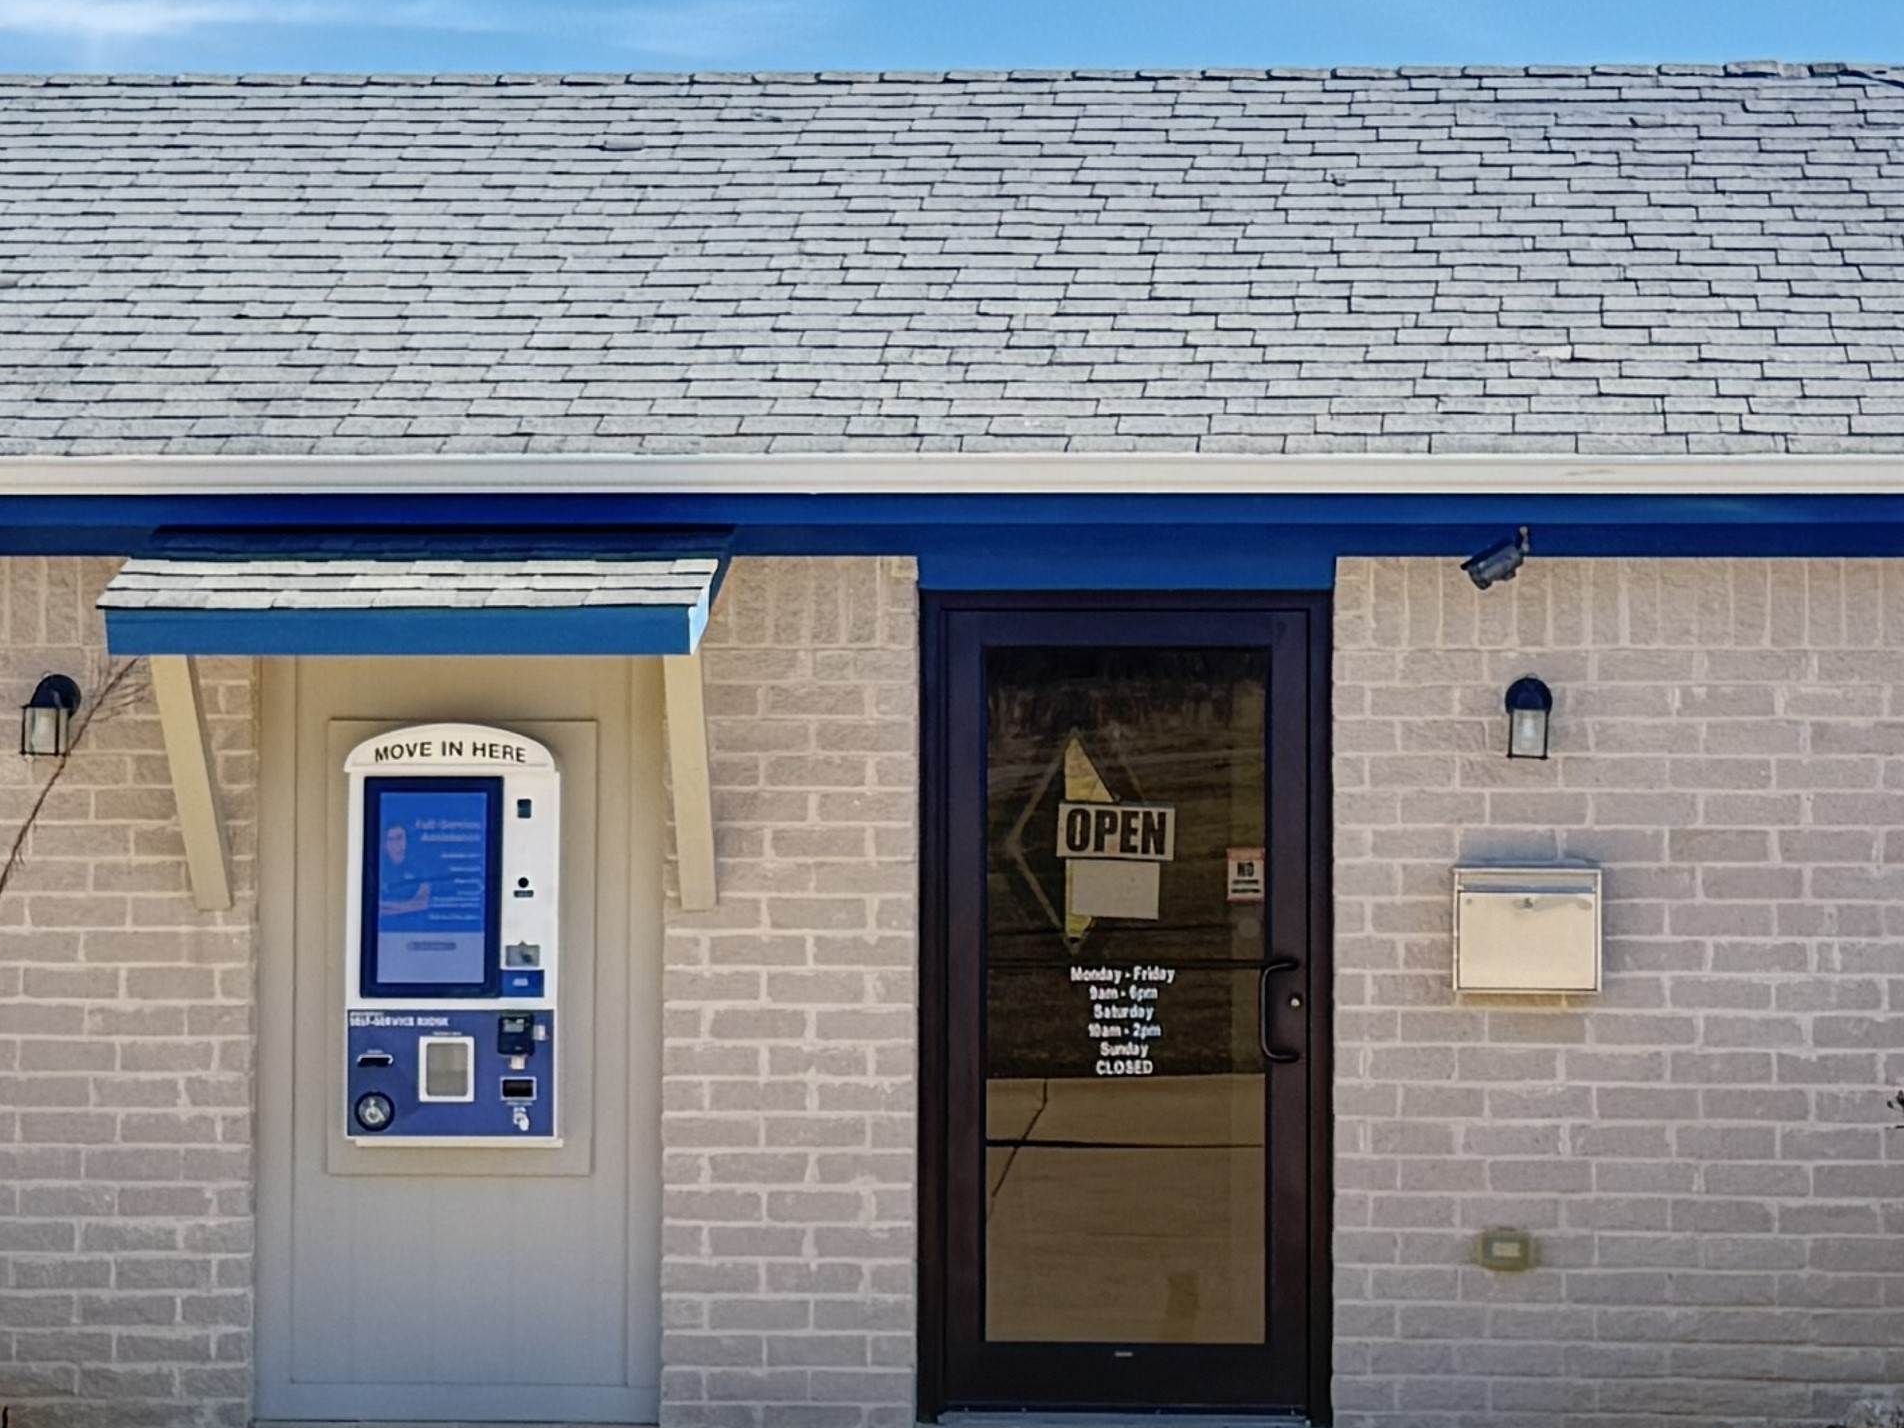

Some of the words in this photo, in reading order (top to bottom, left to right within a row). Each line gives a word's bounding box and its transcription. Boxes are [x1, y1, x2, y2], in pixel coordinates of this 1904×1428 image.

[375, 741, 432, 763] MOVE
[441, 741, 463, 757] IN
[471, 741, 526, 763] HERE
[1065, 808, 1167, 855] OPEN
[1237, 861, 1255, 877] NO
[1070, 966, 1122, 984] Monday
[1133, 965, 1175, 983] Friday
[1089, 985, 1118, 1000] 9am
[1129, 985, 1158, 1001] 6pm
[1094, 1004, 1154, 1021] Saturday
[1133, 1022, 1161, 1039] 2pm
[1100, 1041, 1149, 1058] Sunday
[1096, 1060, 1153, 1075] CLOSED
